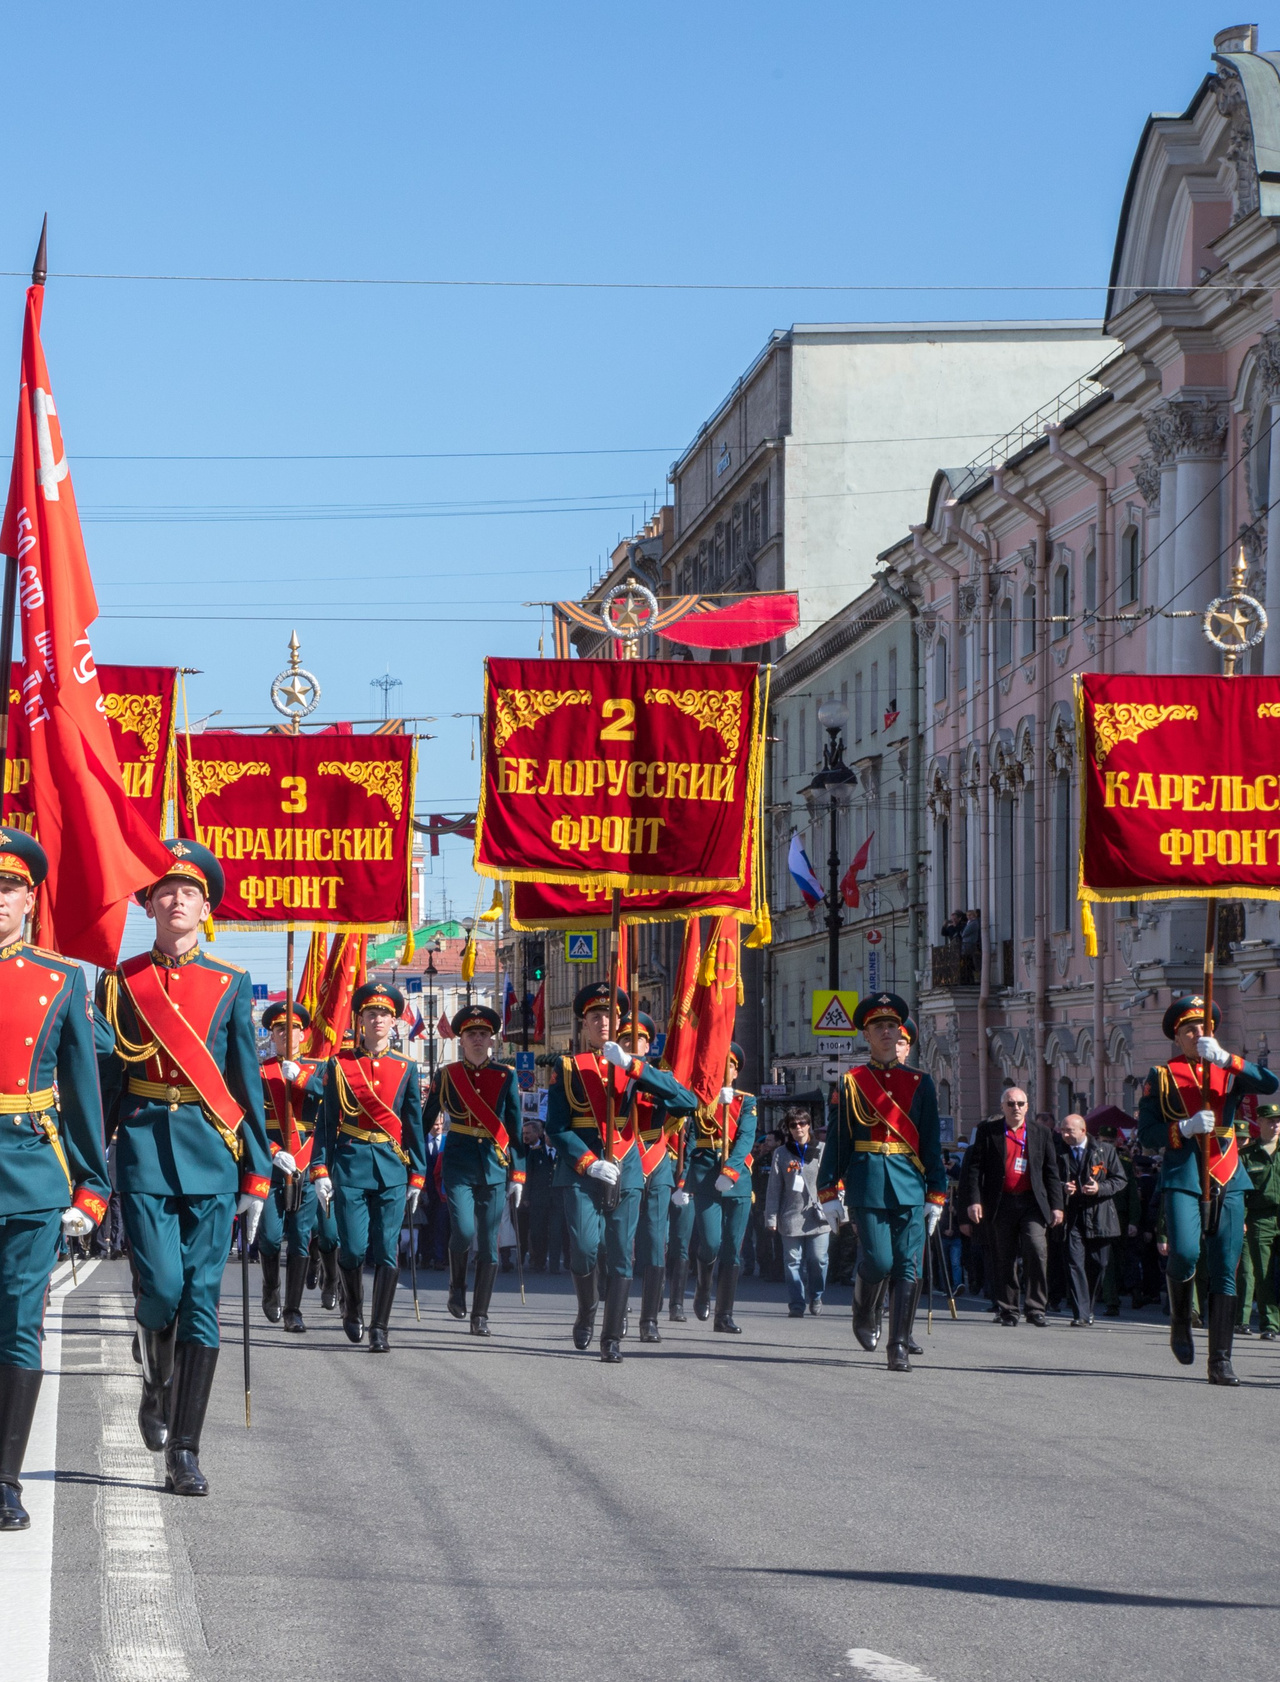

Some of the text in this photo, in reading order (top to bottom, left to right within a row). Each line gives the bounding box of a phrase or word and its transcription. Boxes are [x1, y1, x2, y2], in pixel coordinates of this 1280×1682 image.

[599, 698, 636, 741] 2
[280, 776, 308, 814] 3
[497, 755, 735, 802] БЕЛОРУССКИЙ
[1103, 771, 1280, 812] КАРЕЛЬС
[199, 821, 394, 861] УКРАИНСКИЙ
[550, 814, 666, 854] ФРОНТ
[239, 875, 345, 909] ФРОНТ
[868, 951, 877, 991] AIRLINES
